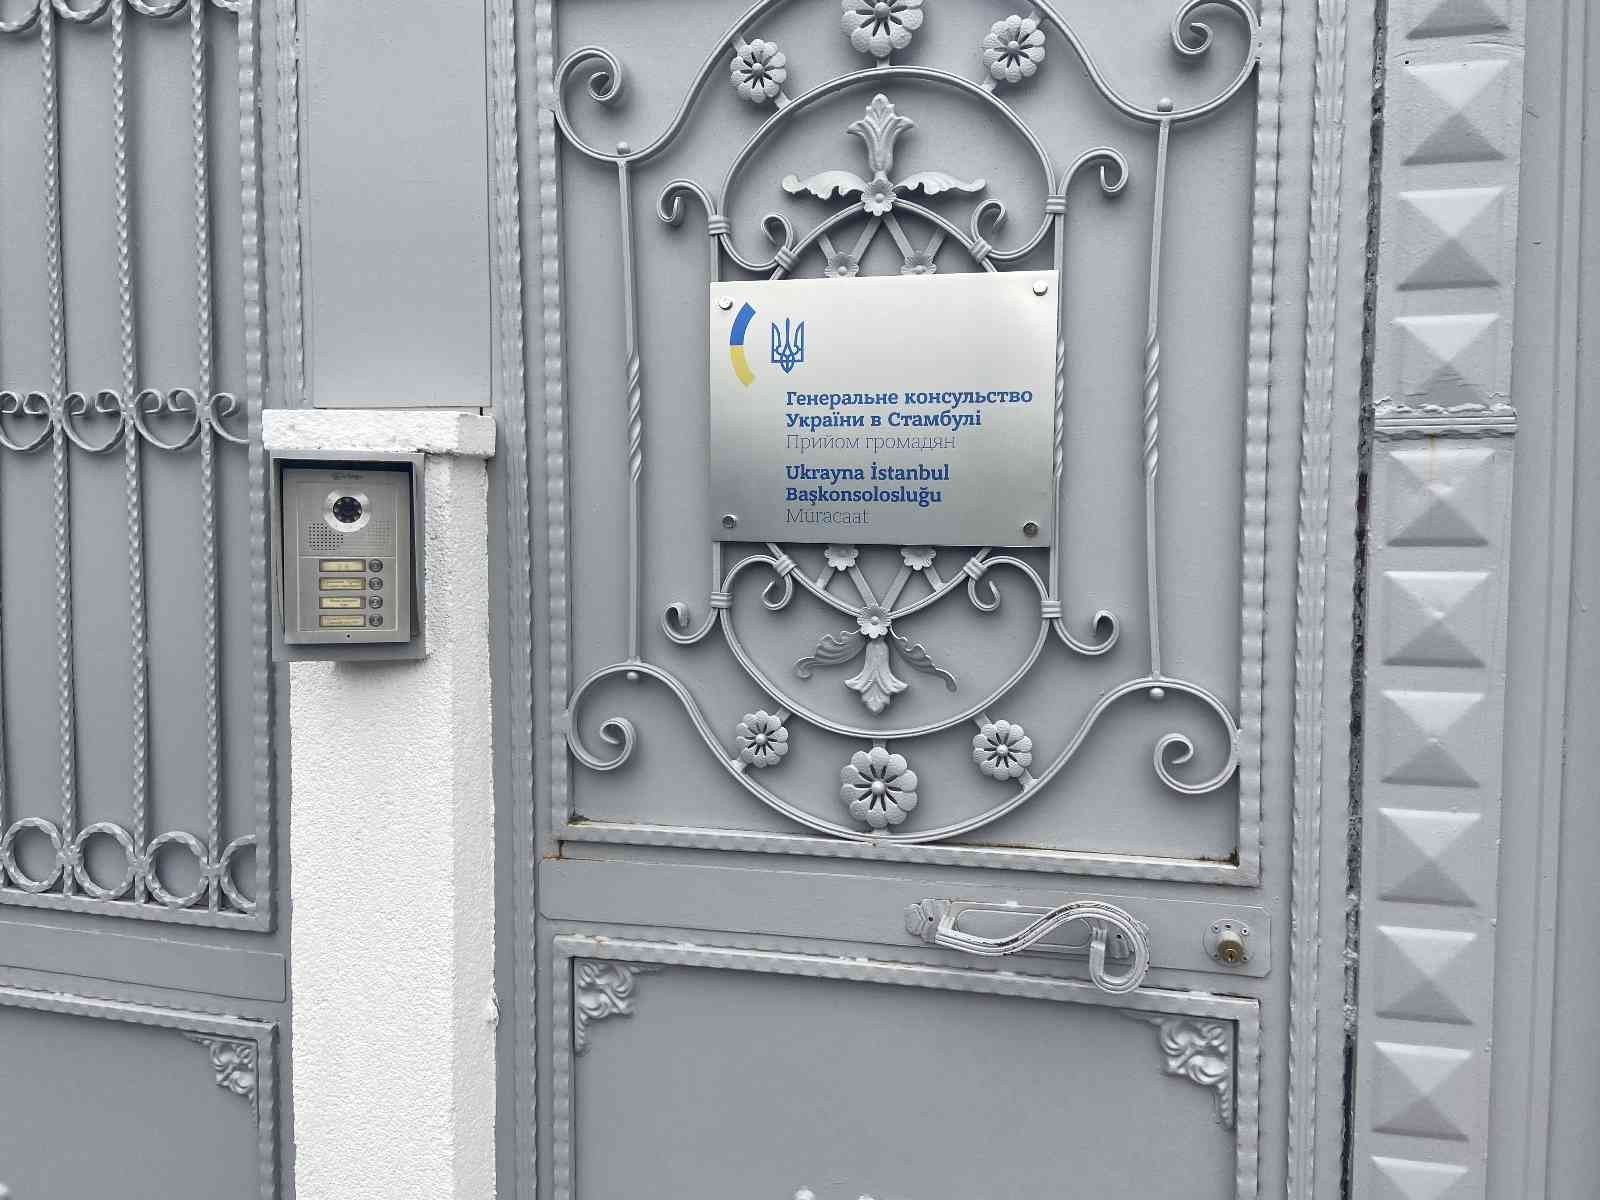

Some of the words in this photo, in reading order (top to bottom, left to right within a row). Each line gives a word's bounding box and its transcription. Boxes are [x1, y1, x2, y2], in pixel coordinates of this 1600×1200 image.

[786, 391, 898, 409] Генеральне
[904, 390, 1033, 408] консульство
[786, 412, 864, 432] України
[871, 416, 882, 427] в
[888, 410, 982, 431] Стамбулі
[786, 433, 860, 453] Прийом
[866, 435, 956, 453] громадян
[786, 464, 865, 484] Ukrayna
[870, 462, 950, 481] İstanbul
[786, 486, 943, 507] Başkonsolosluğu
